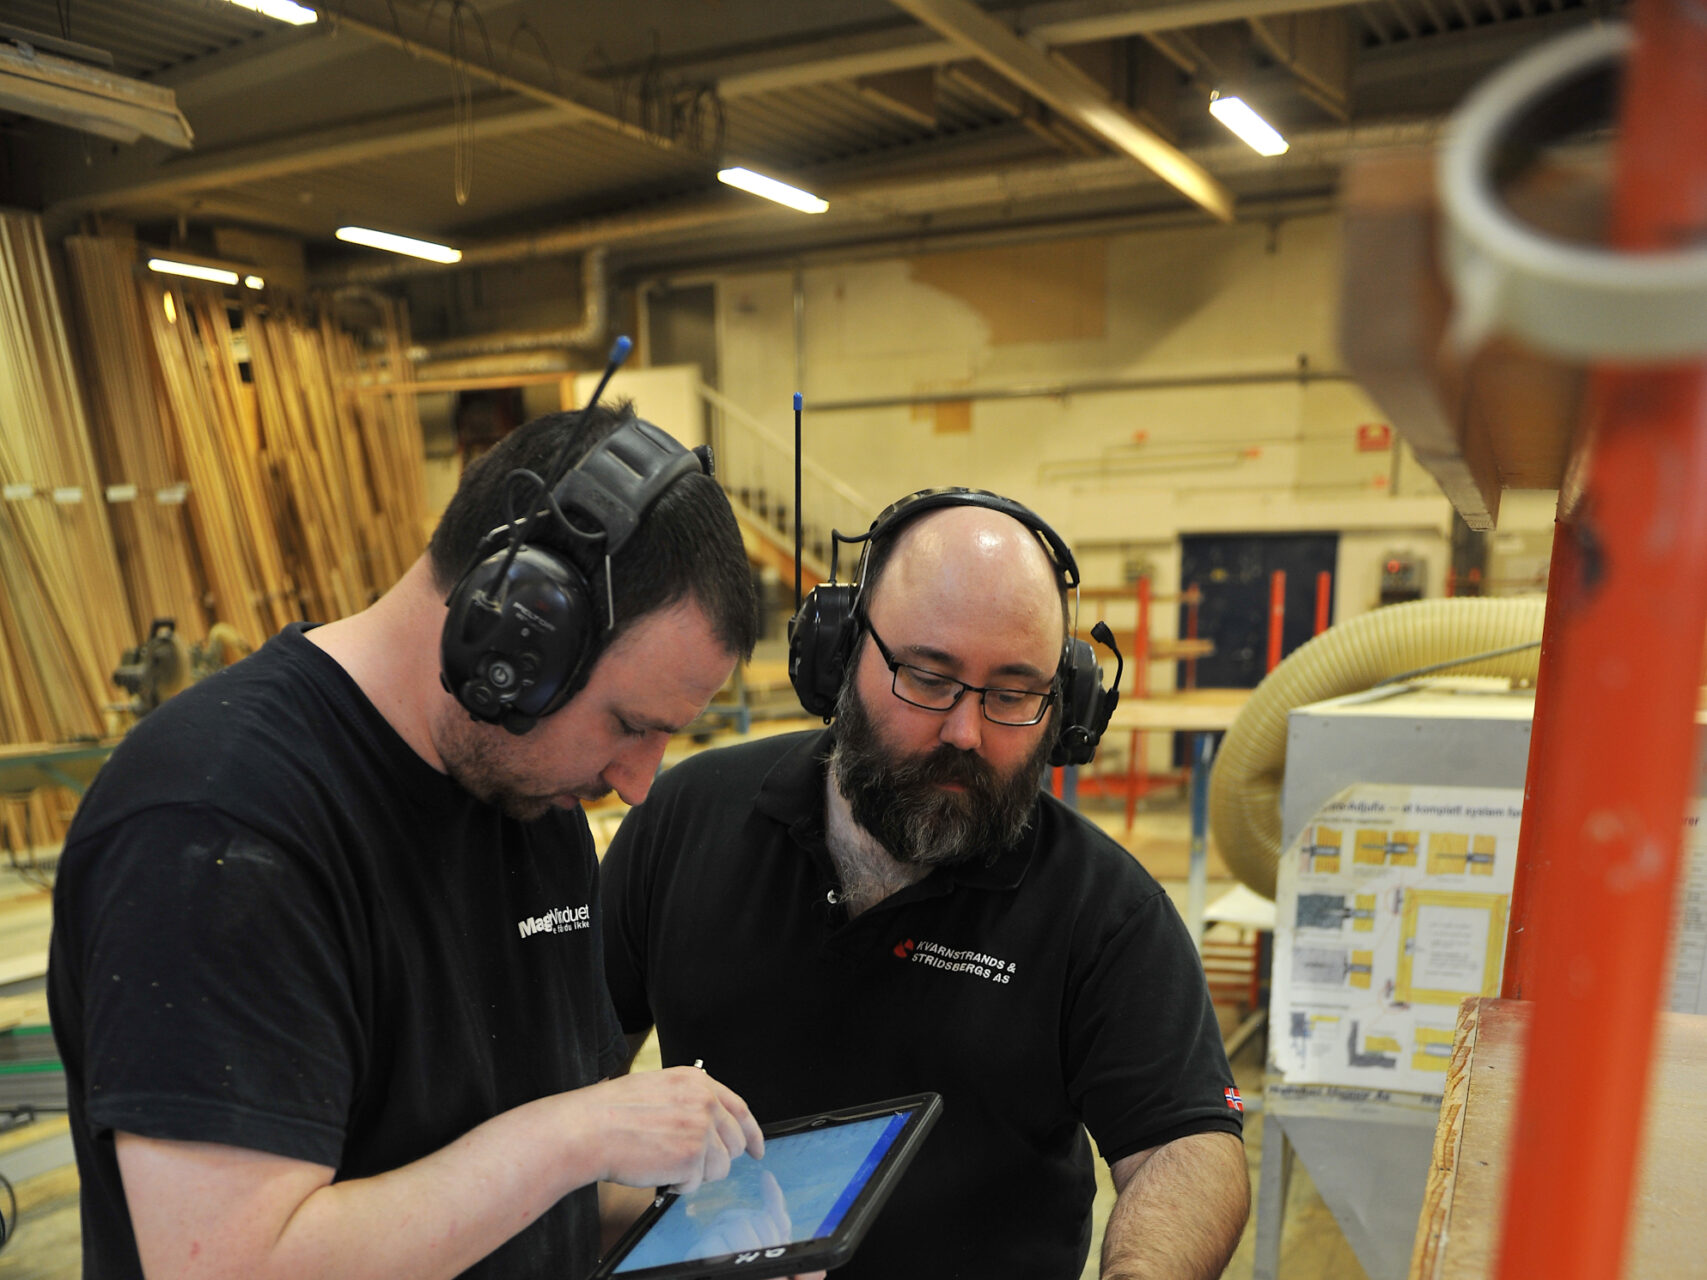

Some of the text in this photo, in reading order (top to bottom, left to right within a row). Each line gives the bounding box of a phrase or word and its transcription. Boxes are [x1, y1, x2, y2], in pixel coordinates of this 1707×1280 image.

[911, 953, 1011, 984] STRIDSBERGS AS
[916, 941, 1017, 973] KVARNSTRANDS &
